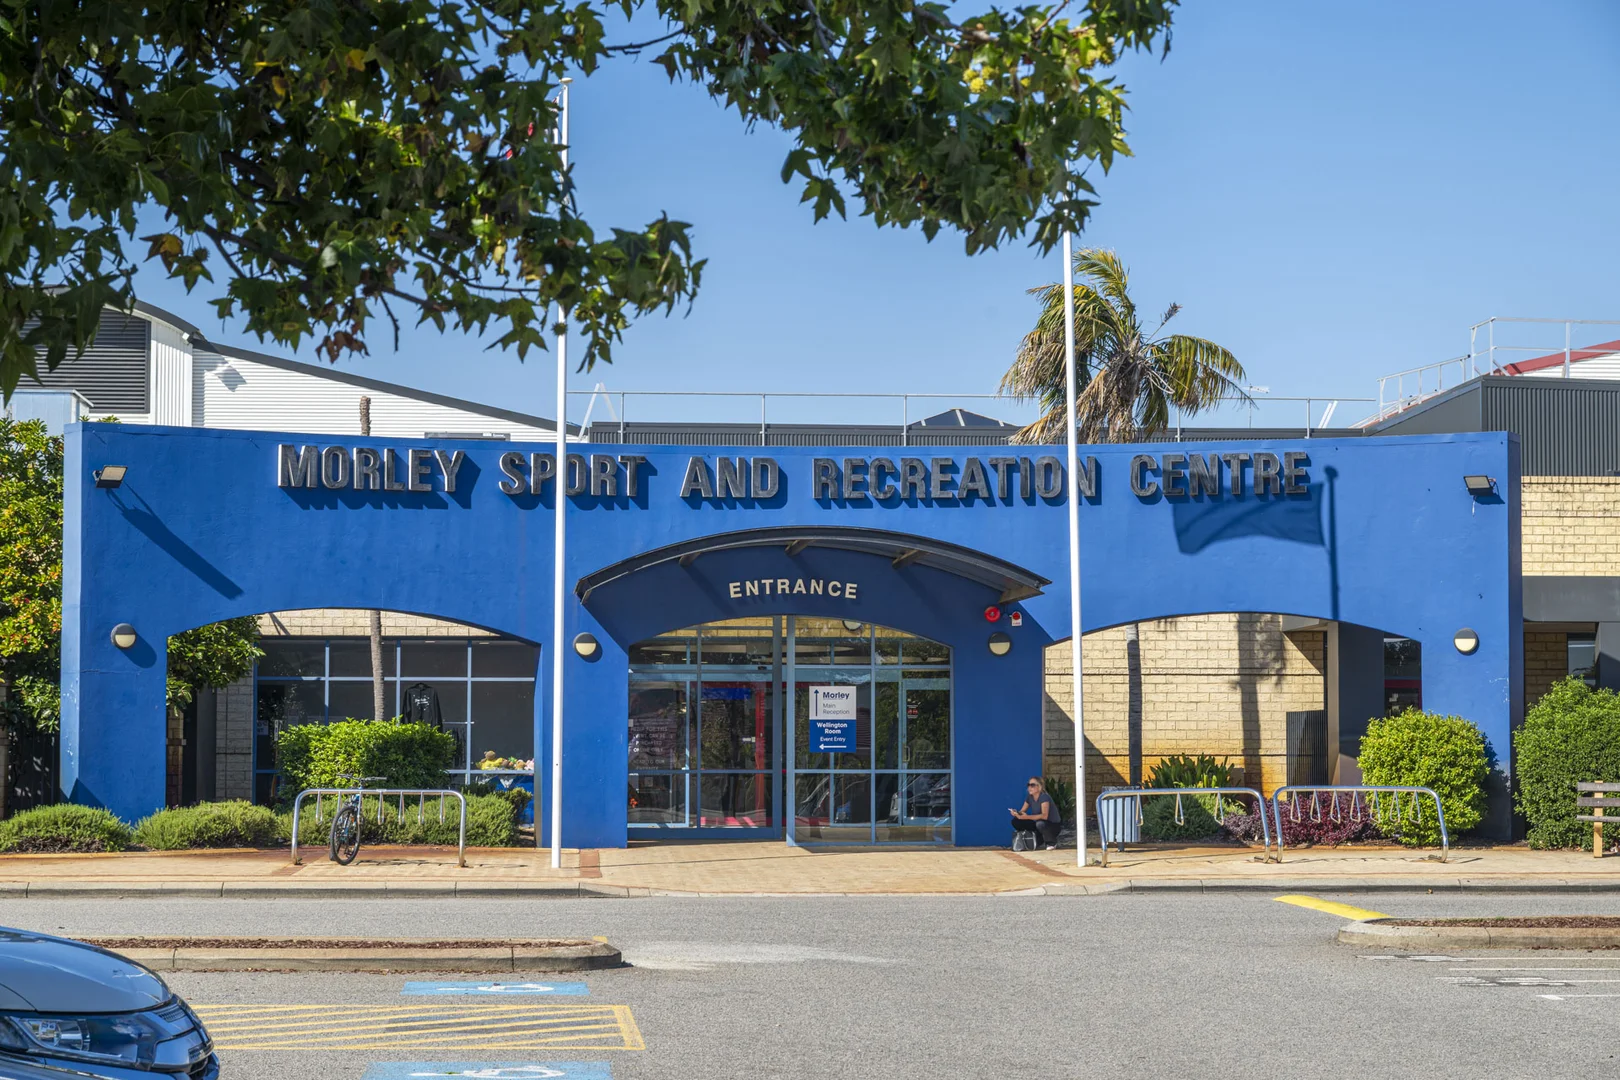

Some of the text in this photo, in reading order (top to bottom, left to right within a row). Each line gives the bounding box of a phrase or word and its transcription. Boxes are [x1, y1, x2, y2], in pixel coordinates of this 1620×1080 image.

[277, 443, 1308, 499] MORLEY SPORT AND RECREATION CENTRE
[728, 578, 858, 599] ENTRANCE
[823, 692, 850, 700] Morley
